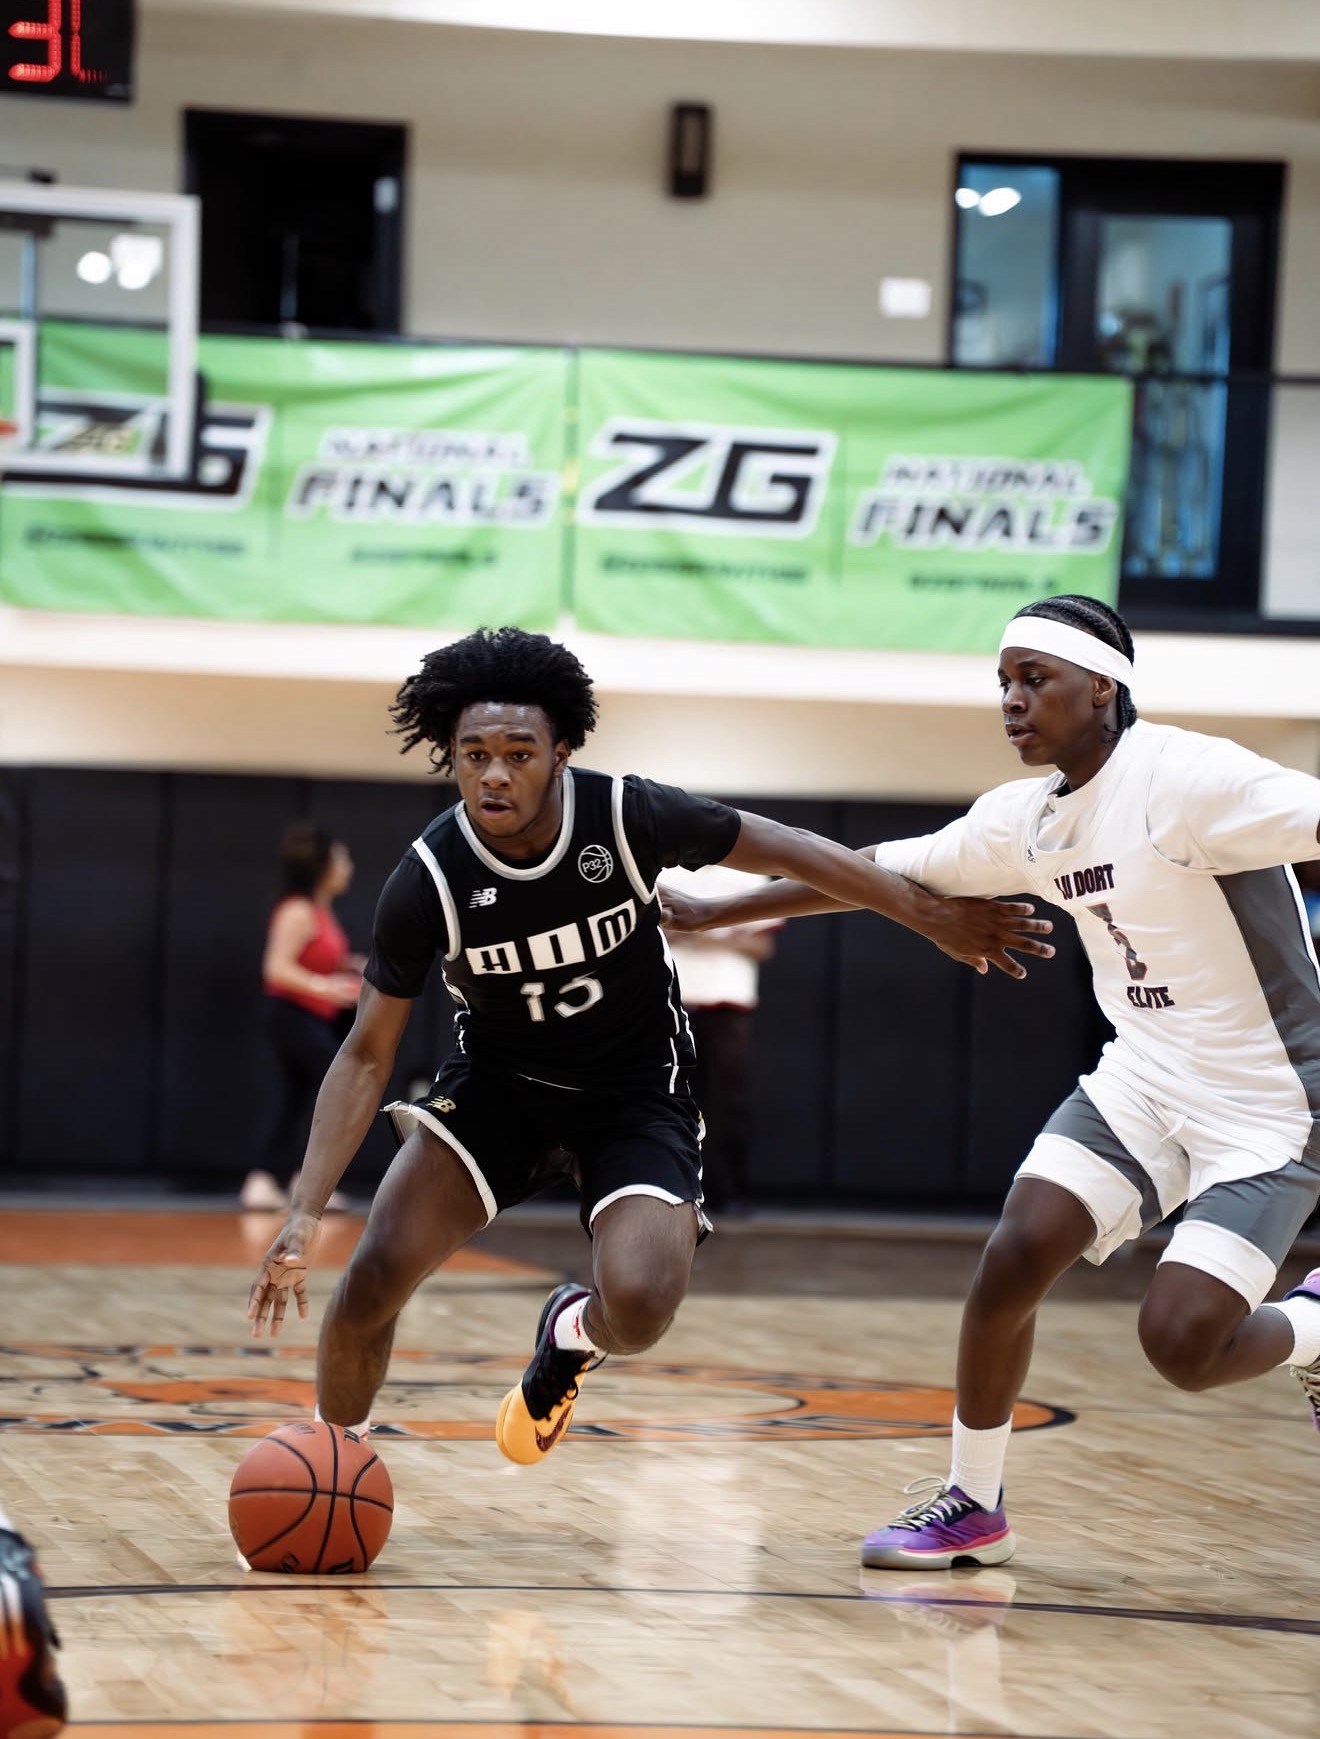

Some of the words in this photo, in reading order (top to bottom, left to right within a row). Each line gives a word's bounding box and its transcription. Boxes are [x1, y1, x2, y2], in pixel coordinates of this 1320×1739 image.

[296, 471, 554, 520] FINALS
[590, 430, 823, 524] ZG
[856, 499, 1116, 547] FINALS
[582, 858, 603, 873] P32
[1073, 863, 1115, 898] DORT
[1127, 986, 1175, 1009] ELITE
